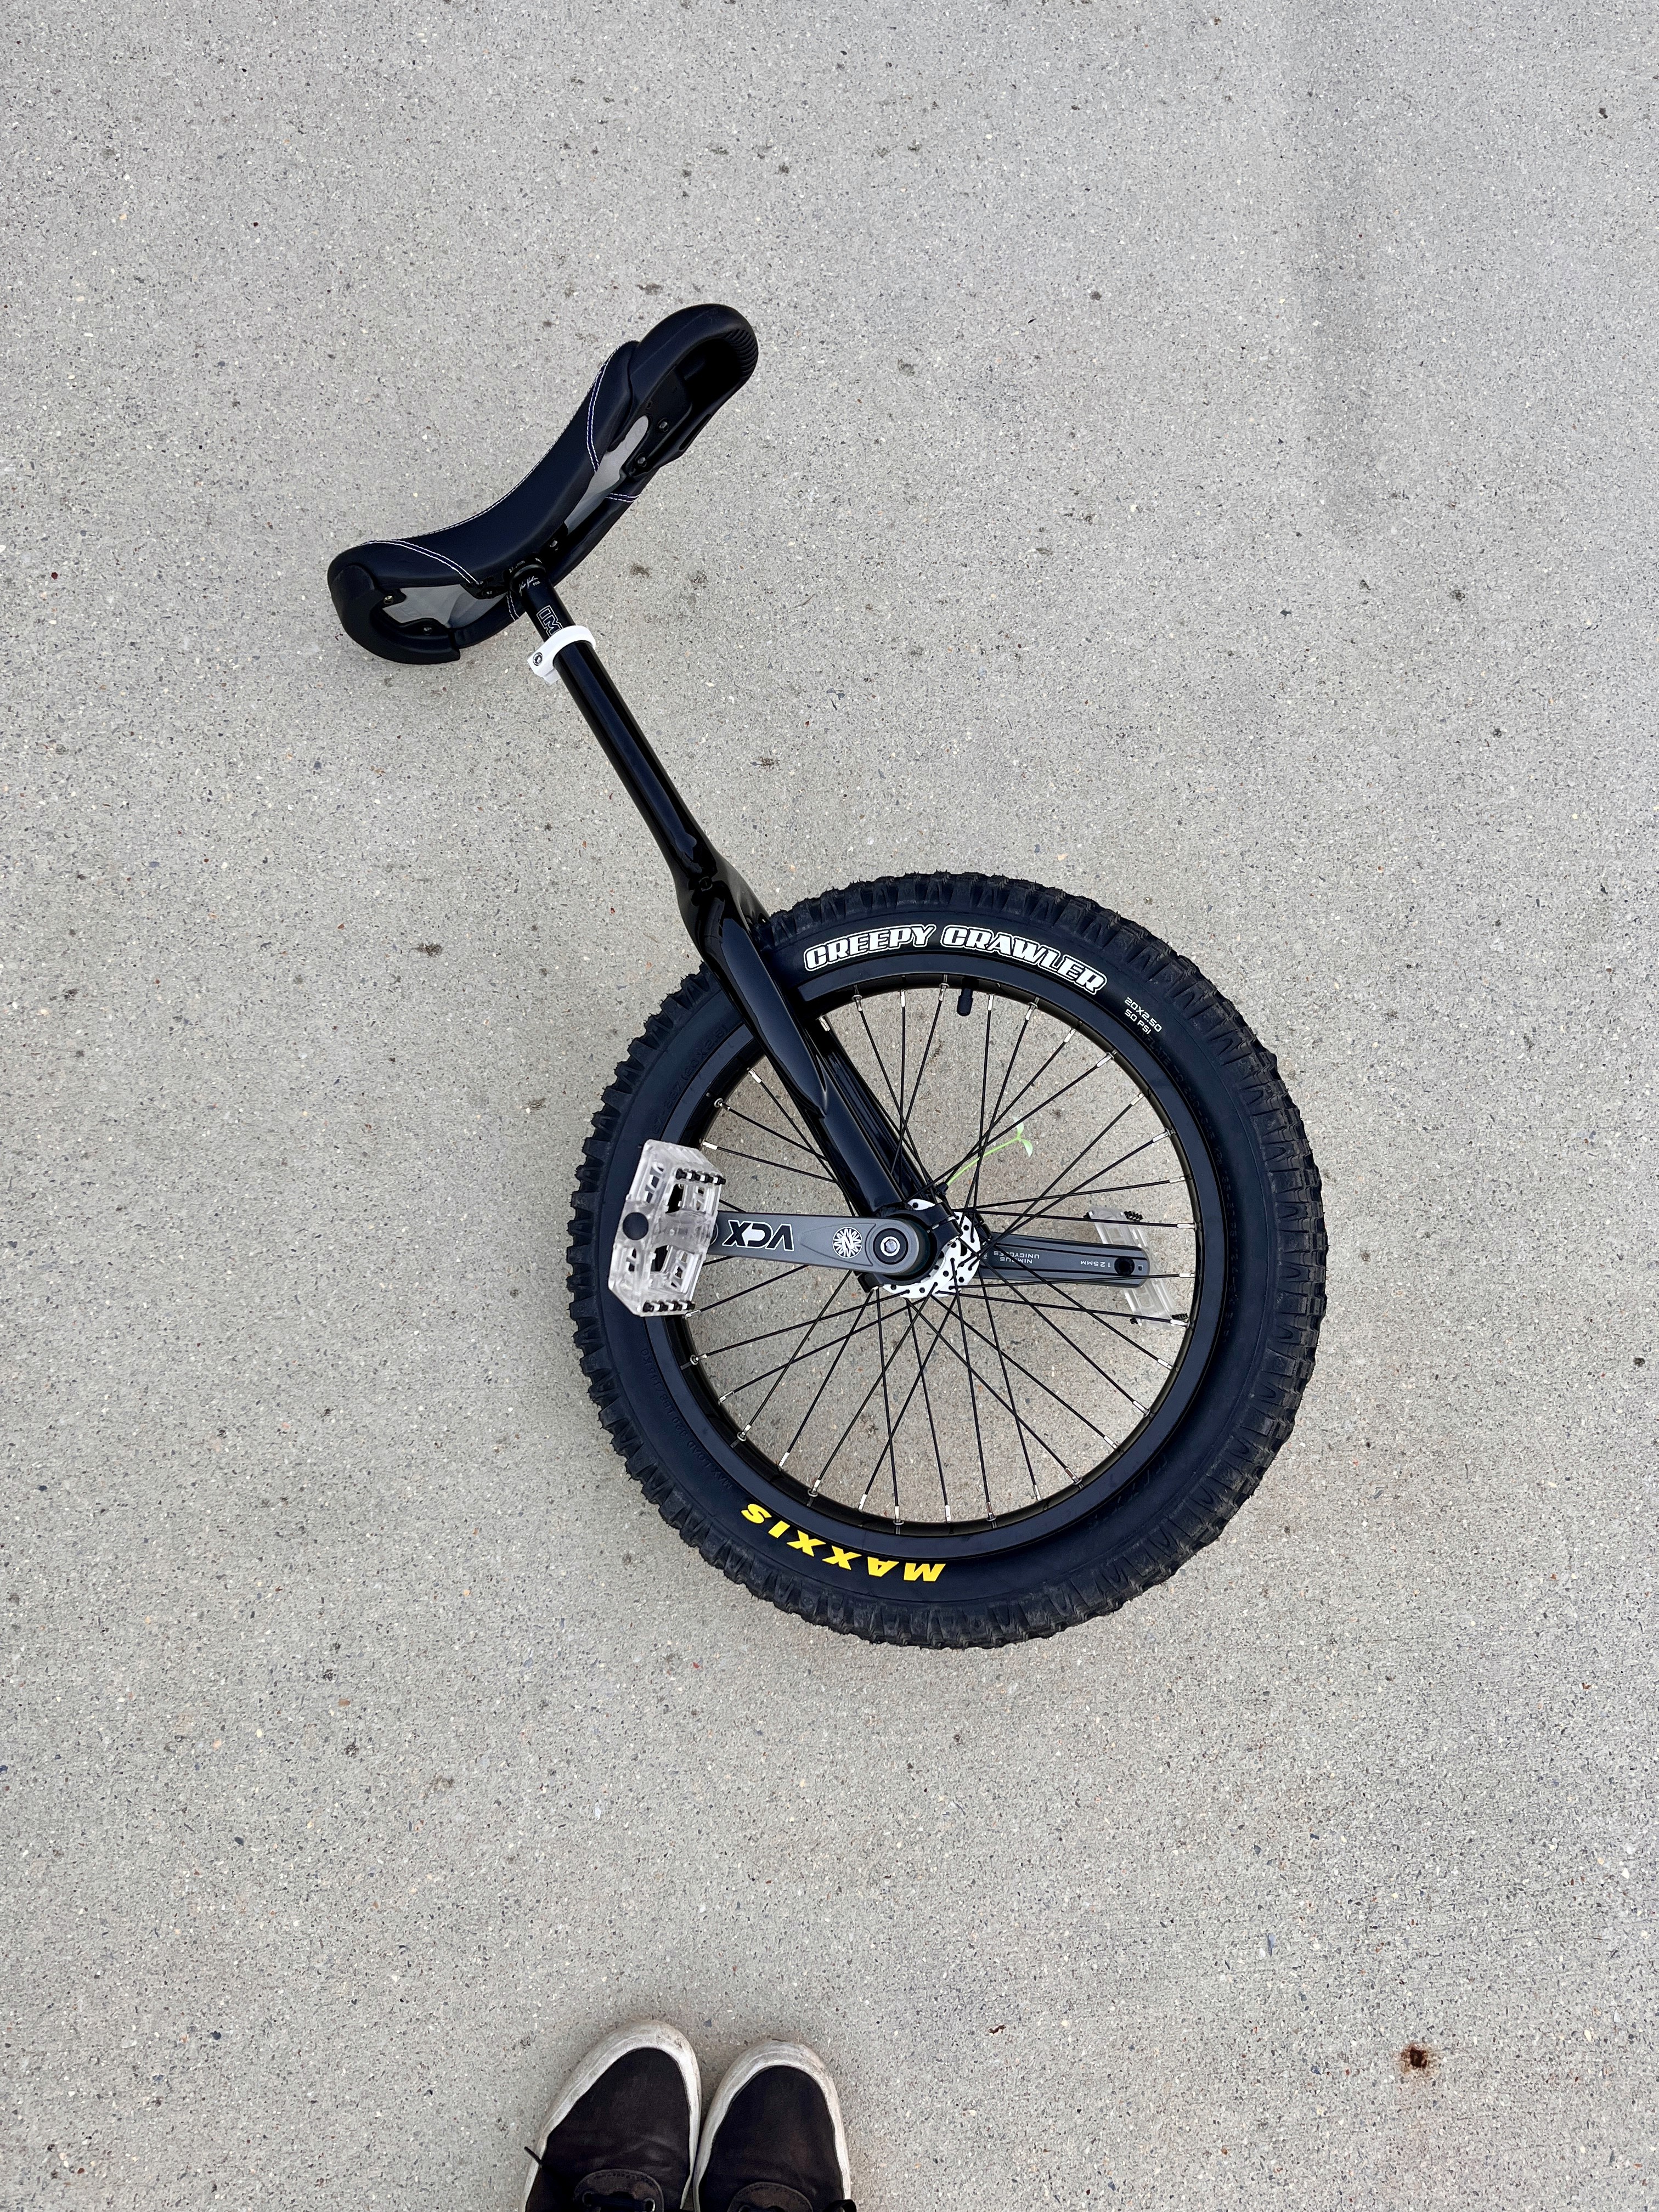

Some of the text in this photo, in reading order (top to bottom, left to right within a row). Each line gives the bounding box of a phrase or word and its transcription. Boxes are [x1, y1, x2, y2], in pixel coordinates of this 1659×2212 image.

[804, 924, 1107, 995] CREEPY CRAWLER
[1124, 997, 1162, 1032] 20X2.50
[1124, 1008, 1152, 1035] 50 PSI
[722, 1219, 795, 1251] VCX
[741, 1504, 946, 1582] MAXXIS
